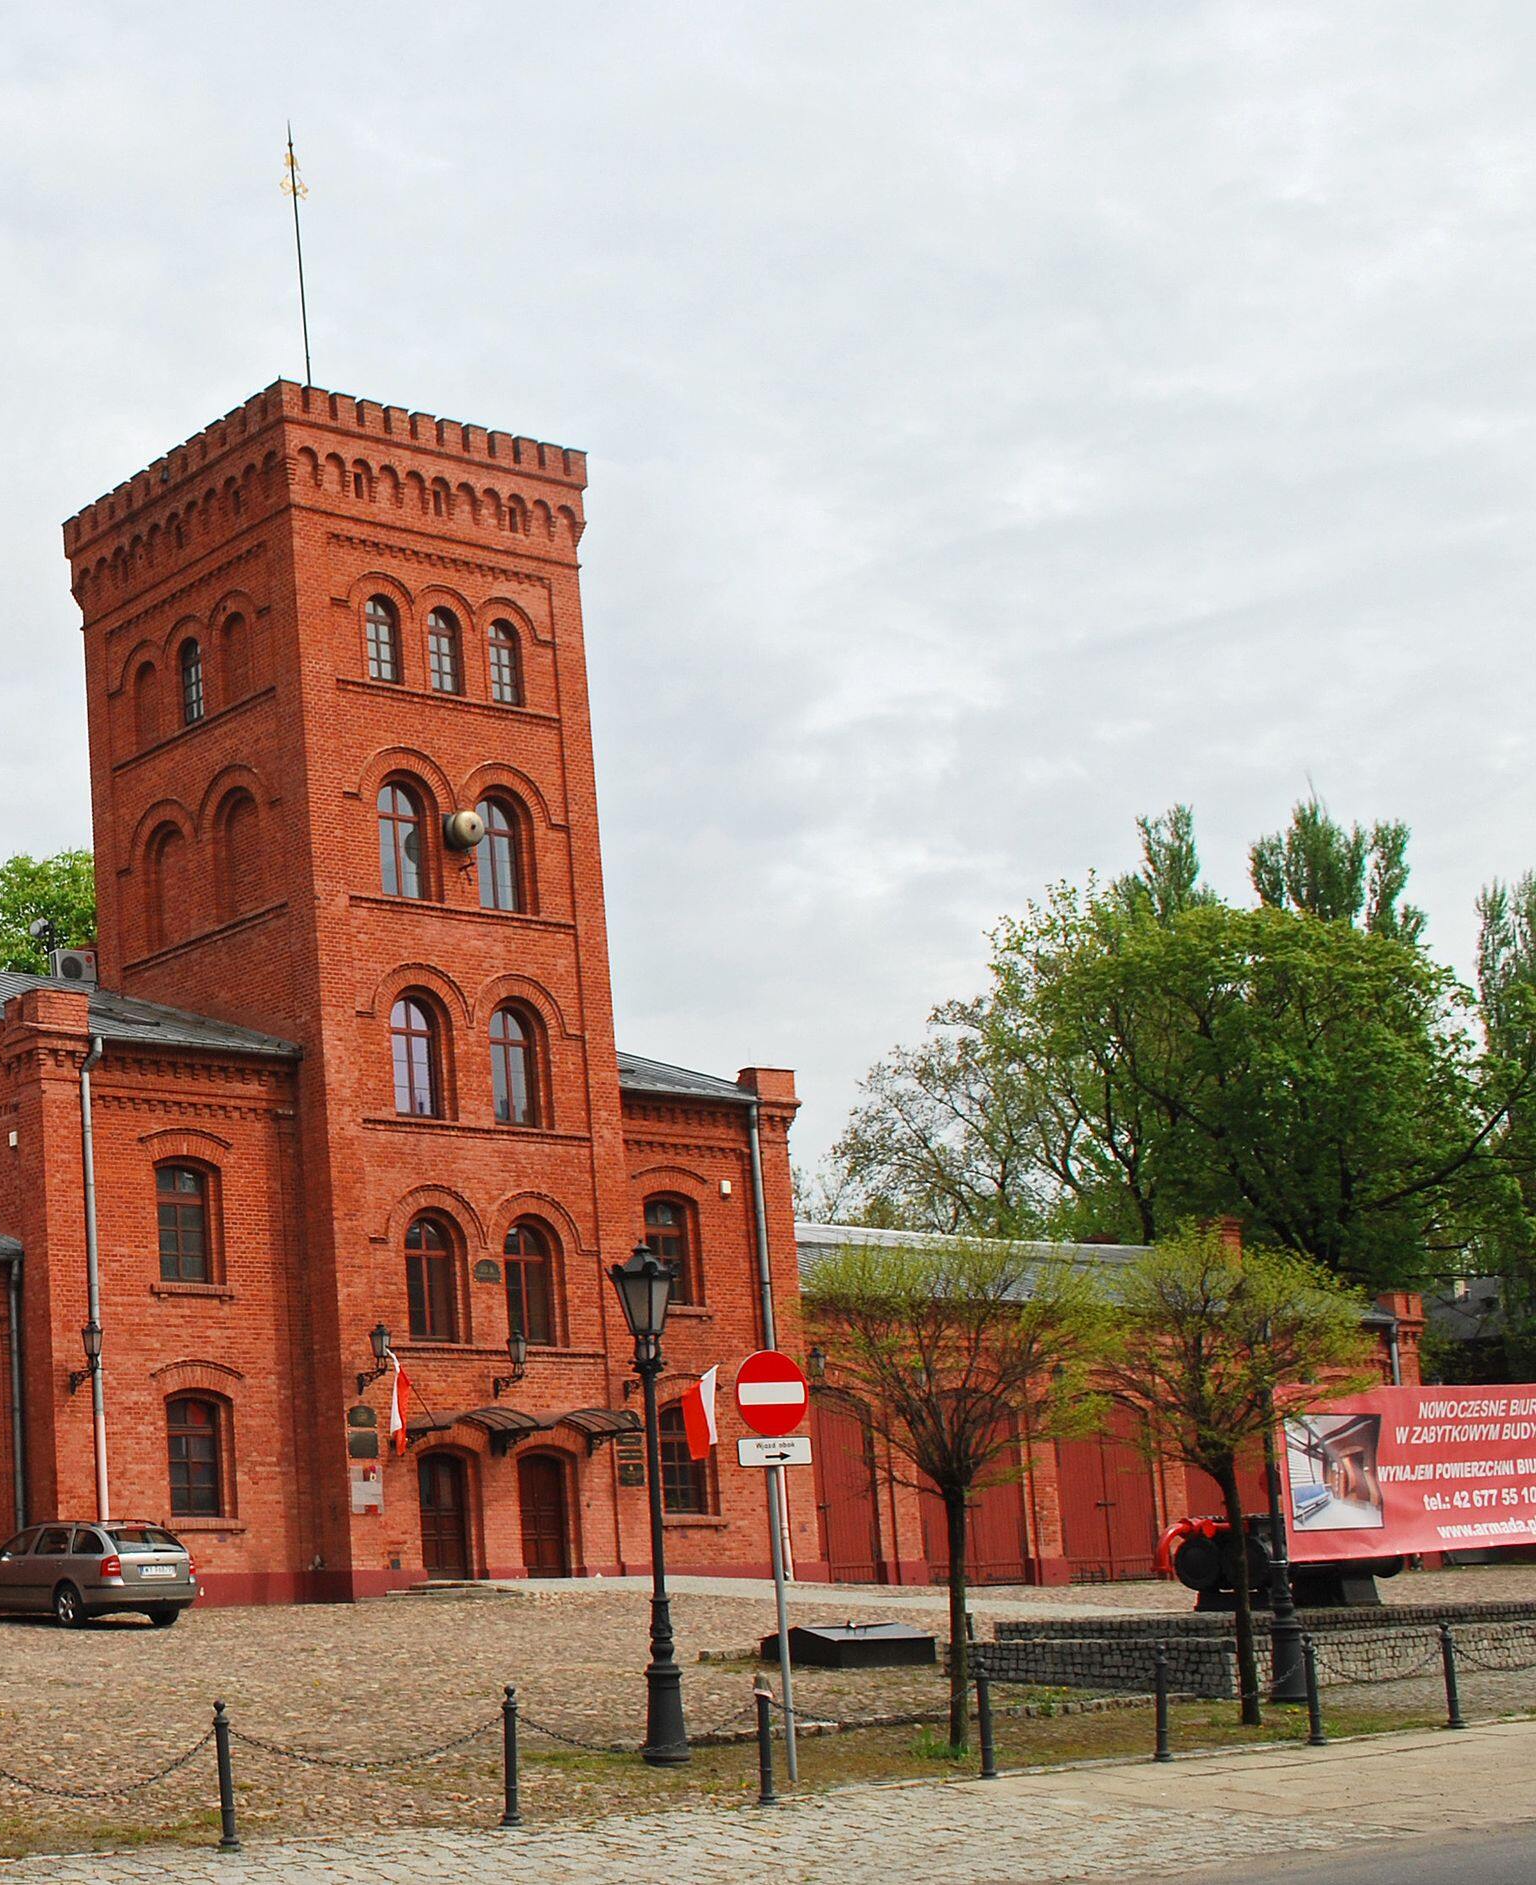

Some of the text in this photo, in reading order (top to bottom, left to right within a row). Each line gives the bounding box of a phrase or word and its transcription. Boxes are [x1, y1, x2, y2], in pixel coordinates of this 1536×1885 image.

[1419, 1400, 1507, 1419] NOWOCZESNE
[1395, 1426, 1410, 1444] W
[1410, 1424, 1500, 1444] ZABYTKOWYM
[1377, 1464, 1433, 1482] WYNAJEM
[1435, 1460, 1515, 1479] POWIERZCHNI
[1423, 1493, 1451, 1510] tel.:
[1453, 1491, 1471, 1508] 42
[1472, 1489, 1498, 1507] 677
[1501, 1487, 1519, 1505] 55
